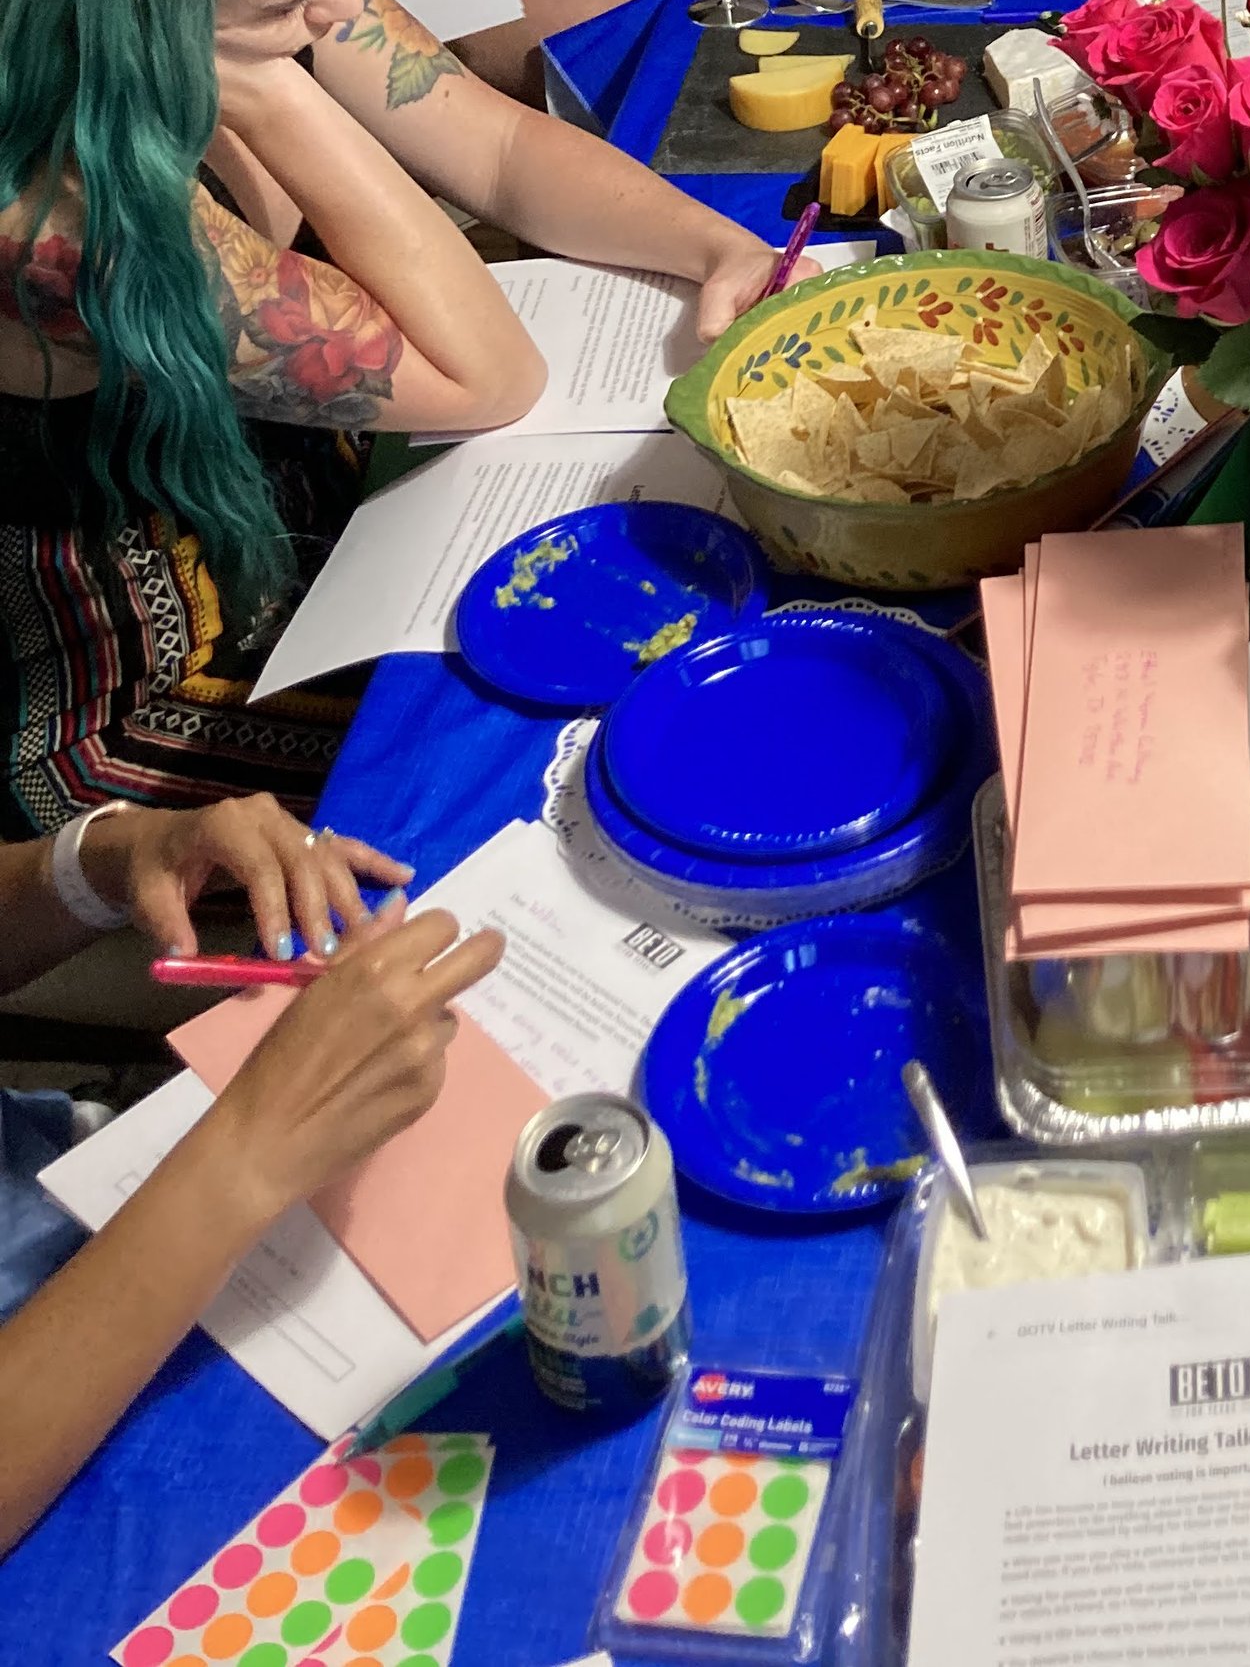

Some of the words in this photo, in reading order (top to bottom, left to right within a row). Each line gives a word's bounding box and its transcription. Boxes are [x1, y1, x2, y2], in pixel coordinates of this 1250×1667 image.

[915, 142, 943, 156] Facts
[943, 133, 985, 149] Nutrition
[626, 925, 681, 966] BETO
[692, 1380, 754, 1398] AVERY
[1175, 1359, 1247, 1405] BETO
[682, 1408, 718, 1426] Color
[720, 1414, 766, 1432] Coding
[767, 1417, 813, 1434] Labels
[1069, 1441, 1130, 1462] Letter
[1136, 1433, 1208, 1458] Writing
[1155, 1467, 1194, 1484] voting
